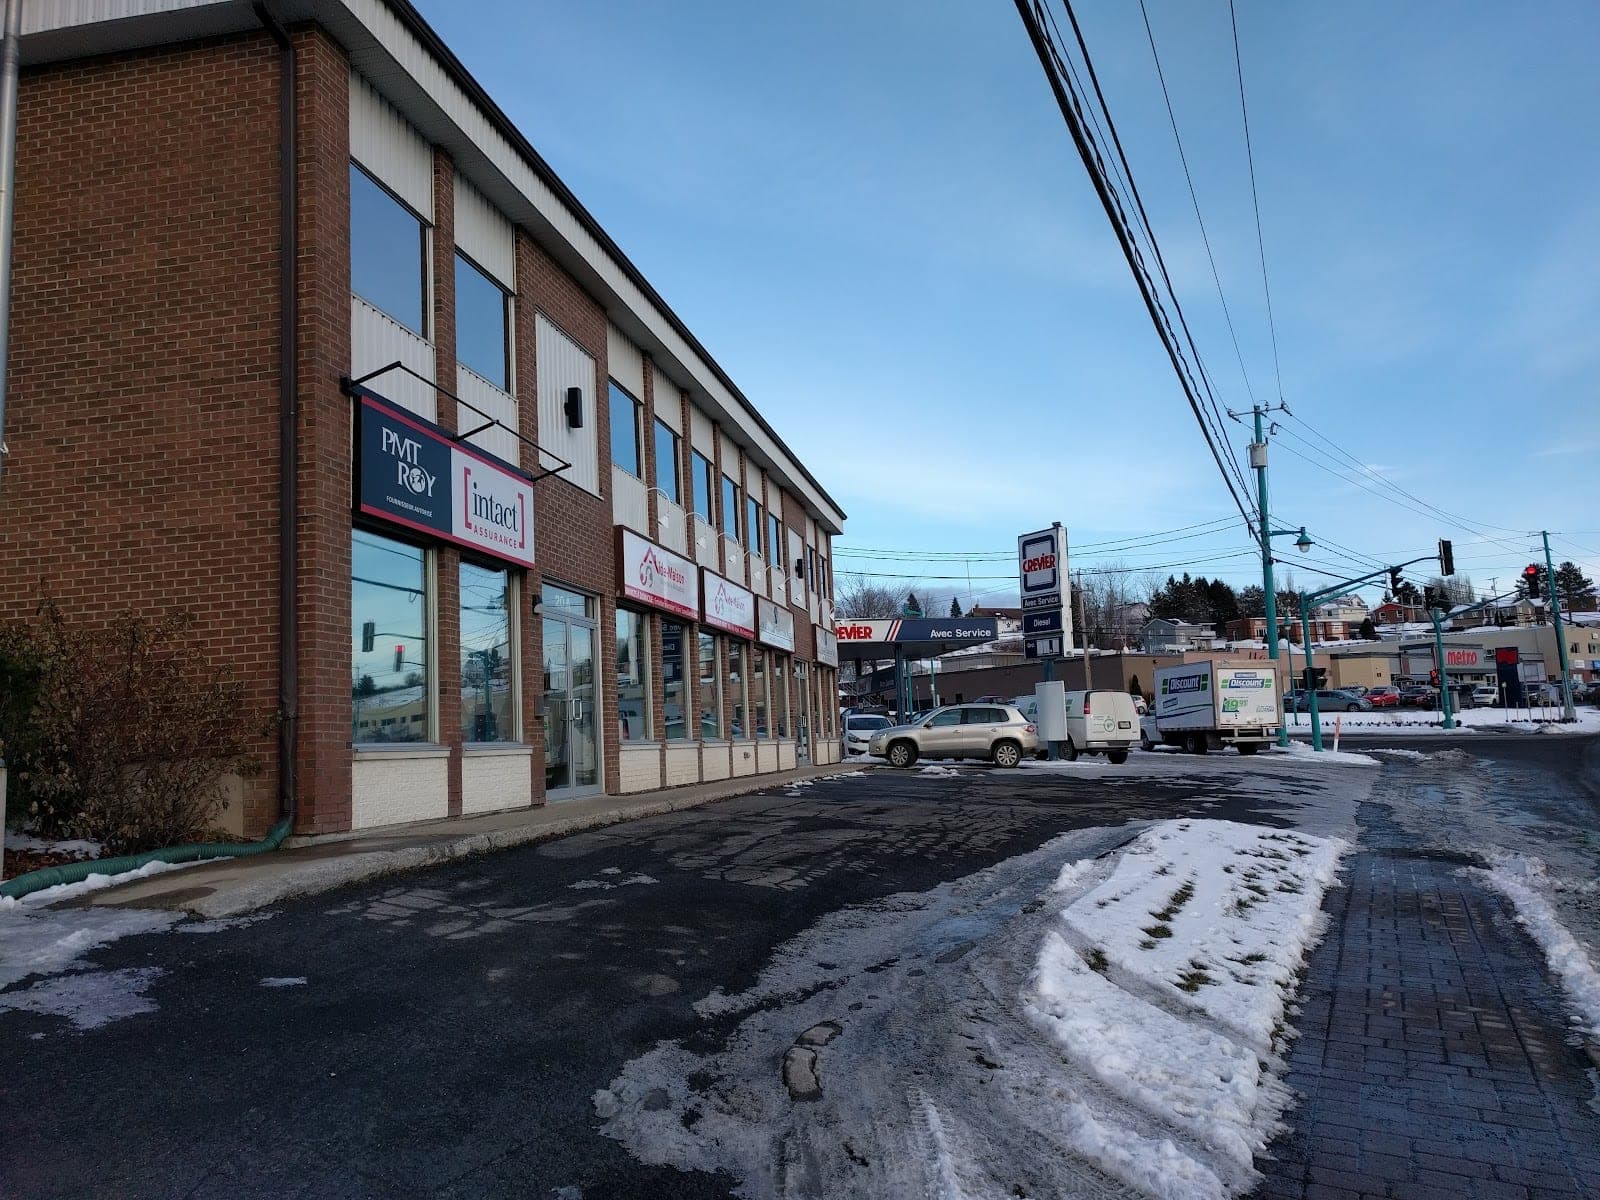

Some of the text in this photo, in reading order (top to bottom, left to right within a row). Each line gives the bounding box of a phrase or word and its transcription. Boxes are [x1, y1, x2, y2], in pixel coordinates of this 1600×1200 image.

[381, 427, 422, 465] PMT
[398, 461, 436, 497] ROY
[473, 482, 518, 532] intact
[473, 524, 518, 549] ASSURANCE
[1038, 595, 1059, 606] Service
[1033, 617, 1051, 627] Diesel
[835, 623, 873, 640] EVIER
[930, 628, 992, 638] Avec Service
[1447, 650, 1477, 665] metro
